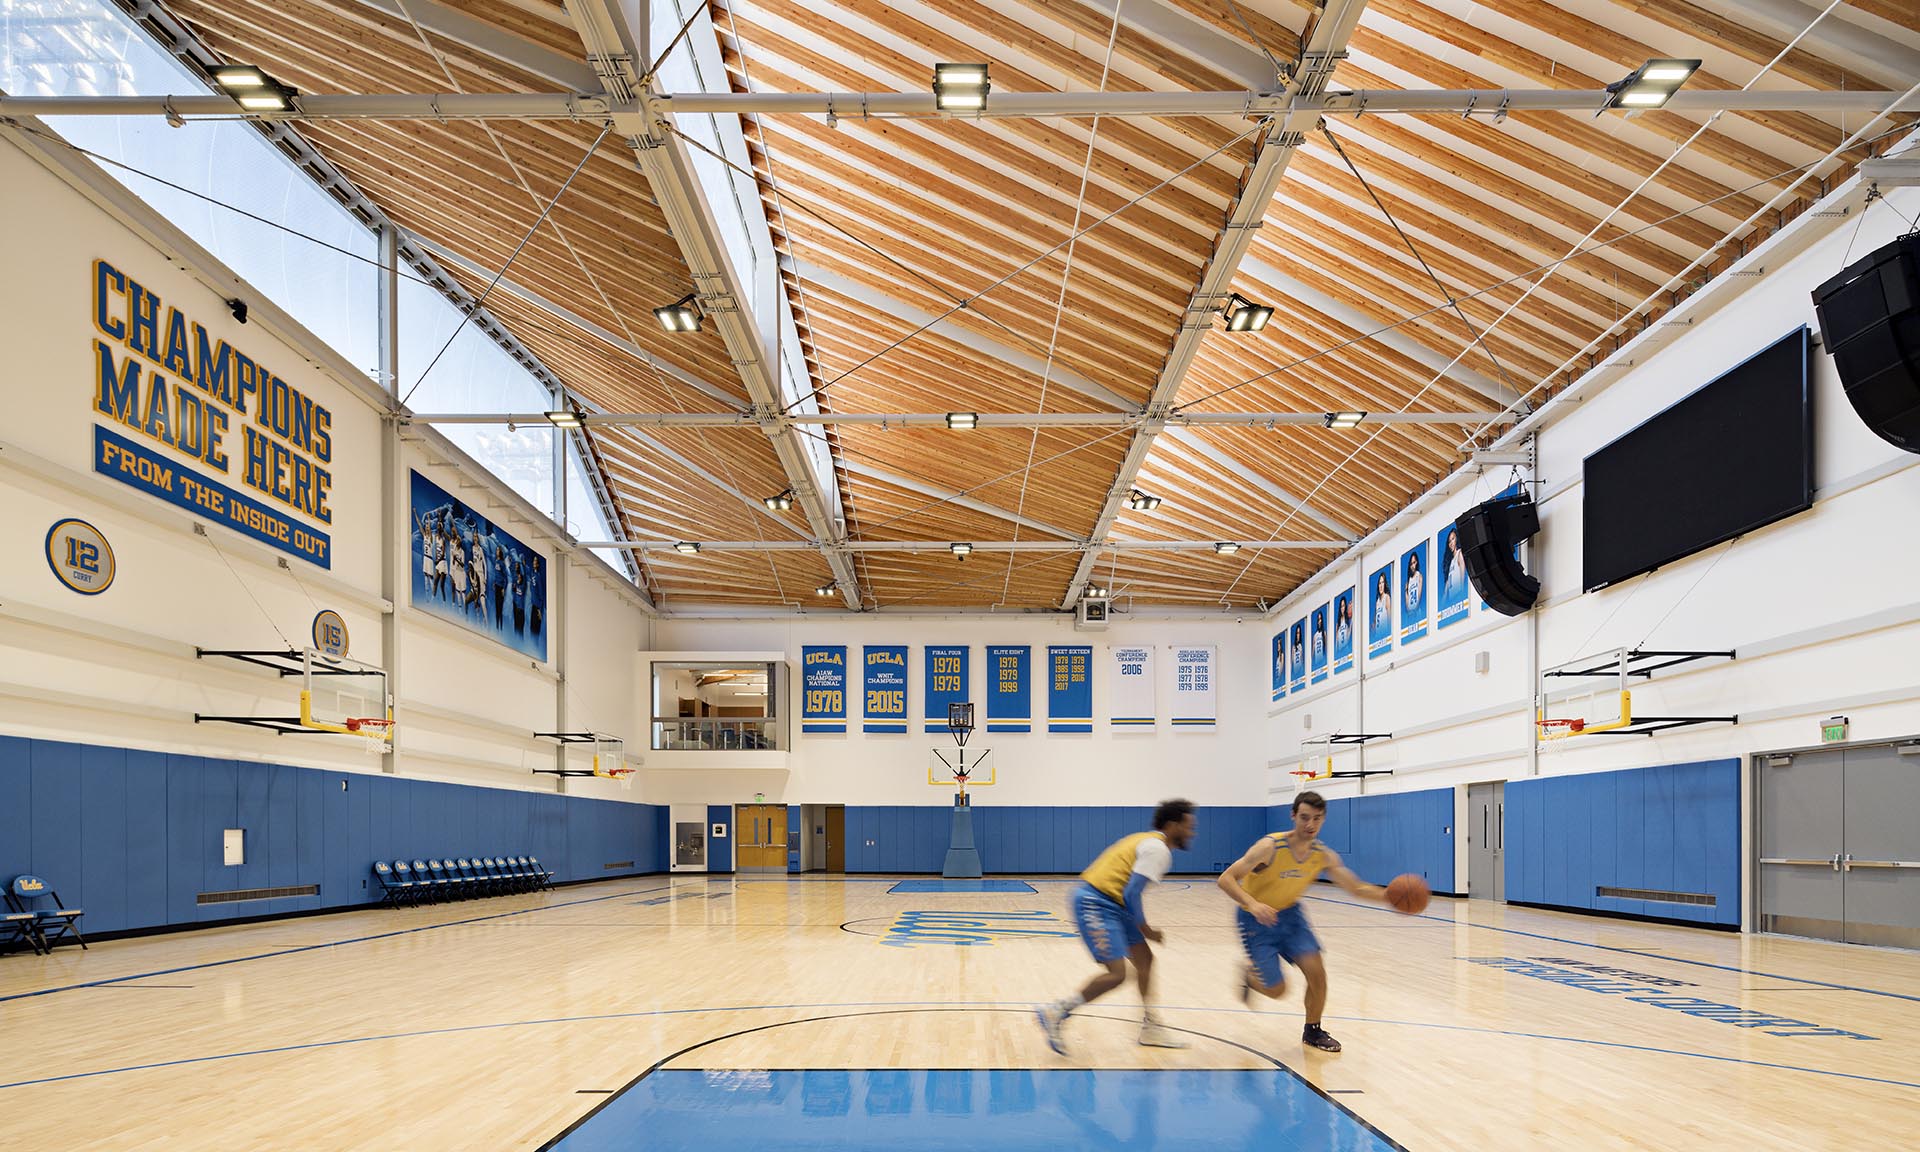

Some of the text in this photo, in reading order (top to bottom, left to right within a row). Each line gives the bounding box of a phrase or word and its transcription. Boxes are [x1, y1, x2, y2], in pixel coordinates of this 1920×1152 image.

[92, 258, 332, 465] CHAMPIONS
[92, 337, 332, 526] MADE HERE
[102, 440, 327, 559] FROM THE INSIDE OUT
[65, 535, 99, 575] 12
[73, 570, 92, 583] CURRY
[323, 622, 341, 648] 15
[805, 652, 843, 666] UCLA
[867, 652, 904, 666] UCLA
[933, 657, 961, 673] 1978
[999, 657, 1018, 668] 1978
[1072, 656, 1085, 664] 1979
[999, 669, 1018, 680] 1979
[1121, 664, 1143, 675] 2006
[1178, 665, 1209, 674] 1975 1976
[933, 675, 961, 692] 1979
[1055, 673, 1085, 682] 1999 2016
[1178, 674, 1209, 682] 1977 1978
[999, 681, 1018, 693] 1999
[1055, 681, 1068, 691] 2017
[1178, 682, 1209, 691] 1979 1999
[806, 690, 843, 713] 1978
[867, 690, 904, 713] 2015
[1824, 726, 1844, 741] EXIT
[1625, 996, 1884, 1041] COURT
